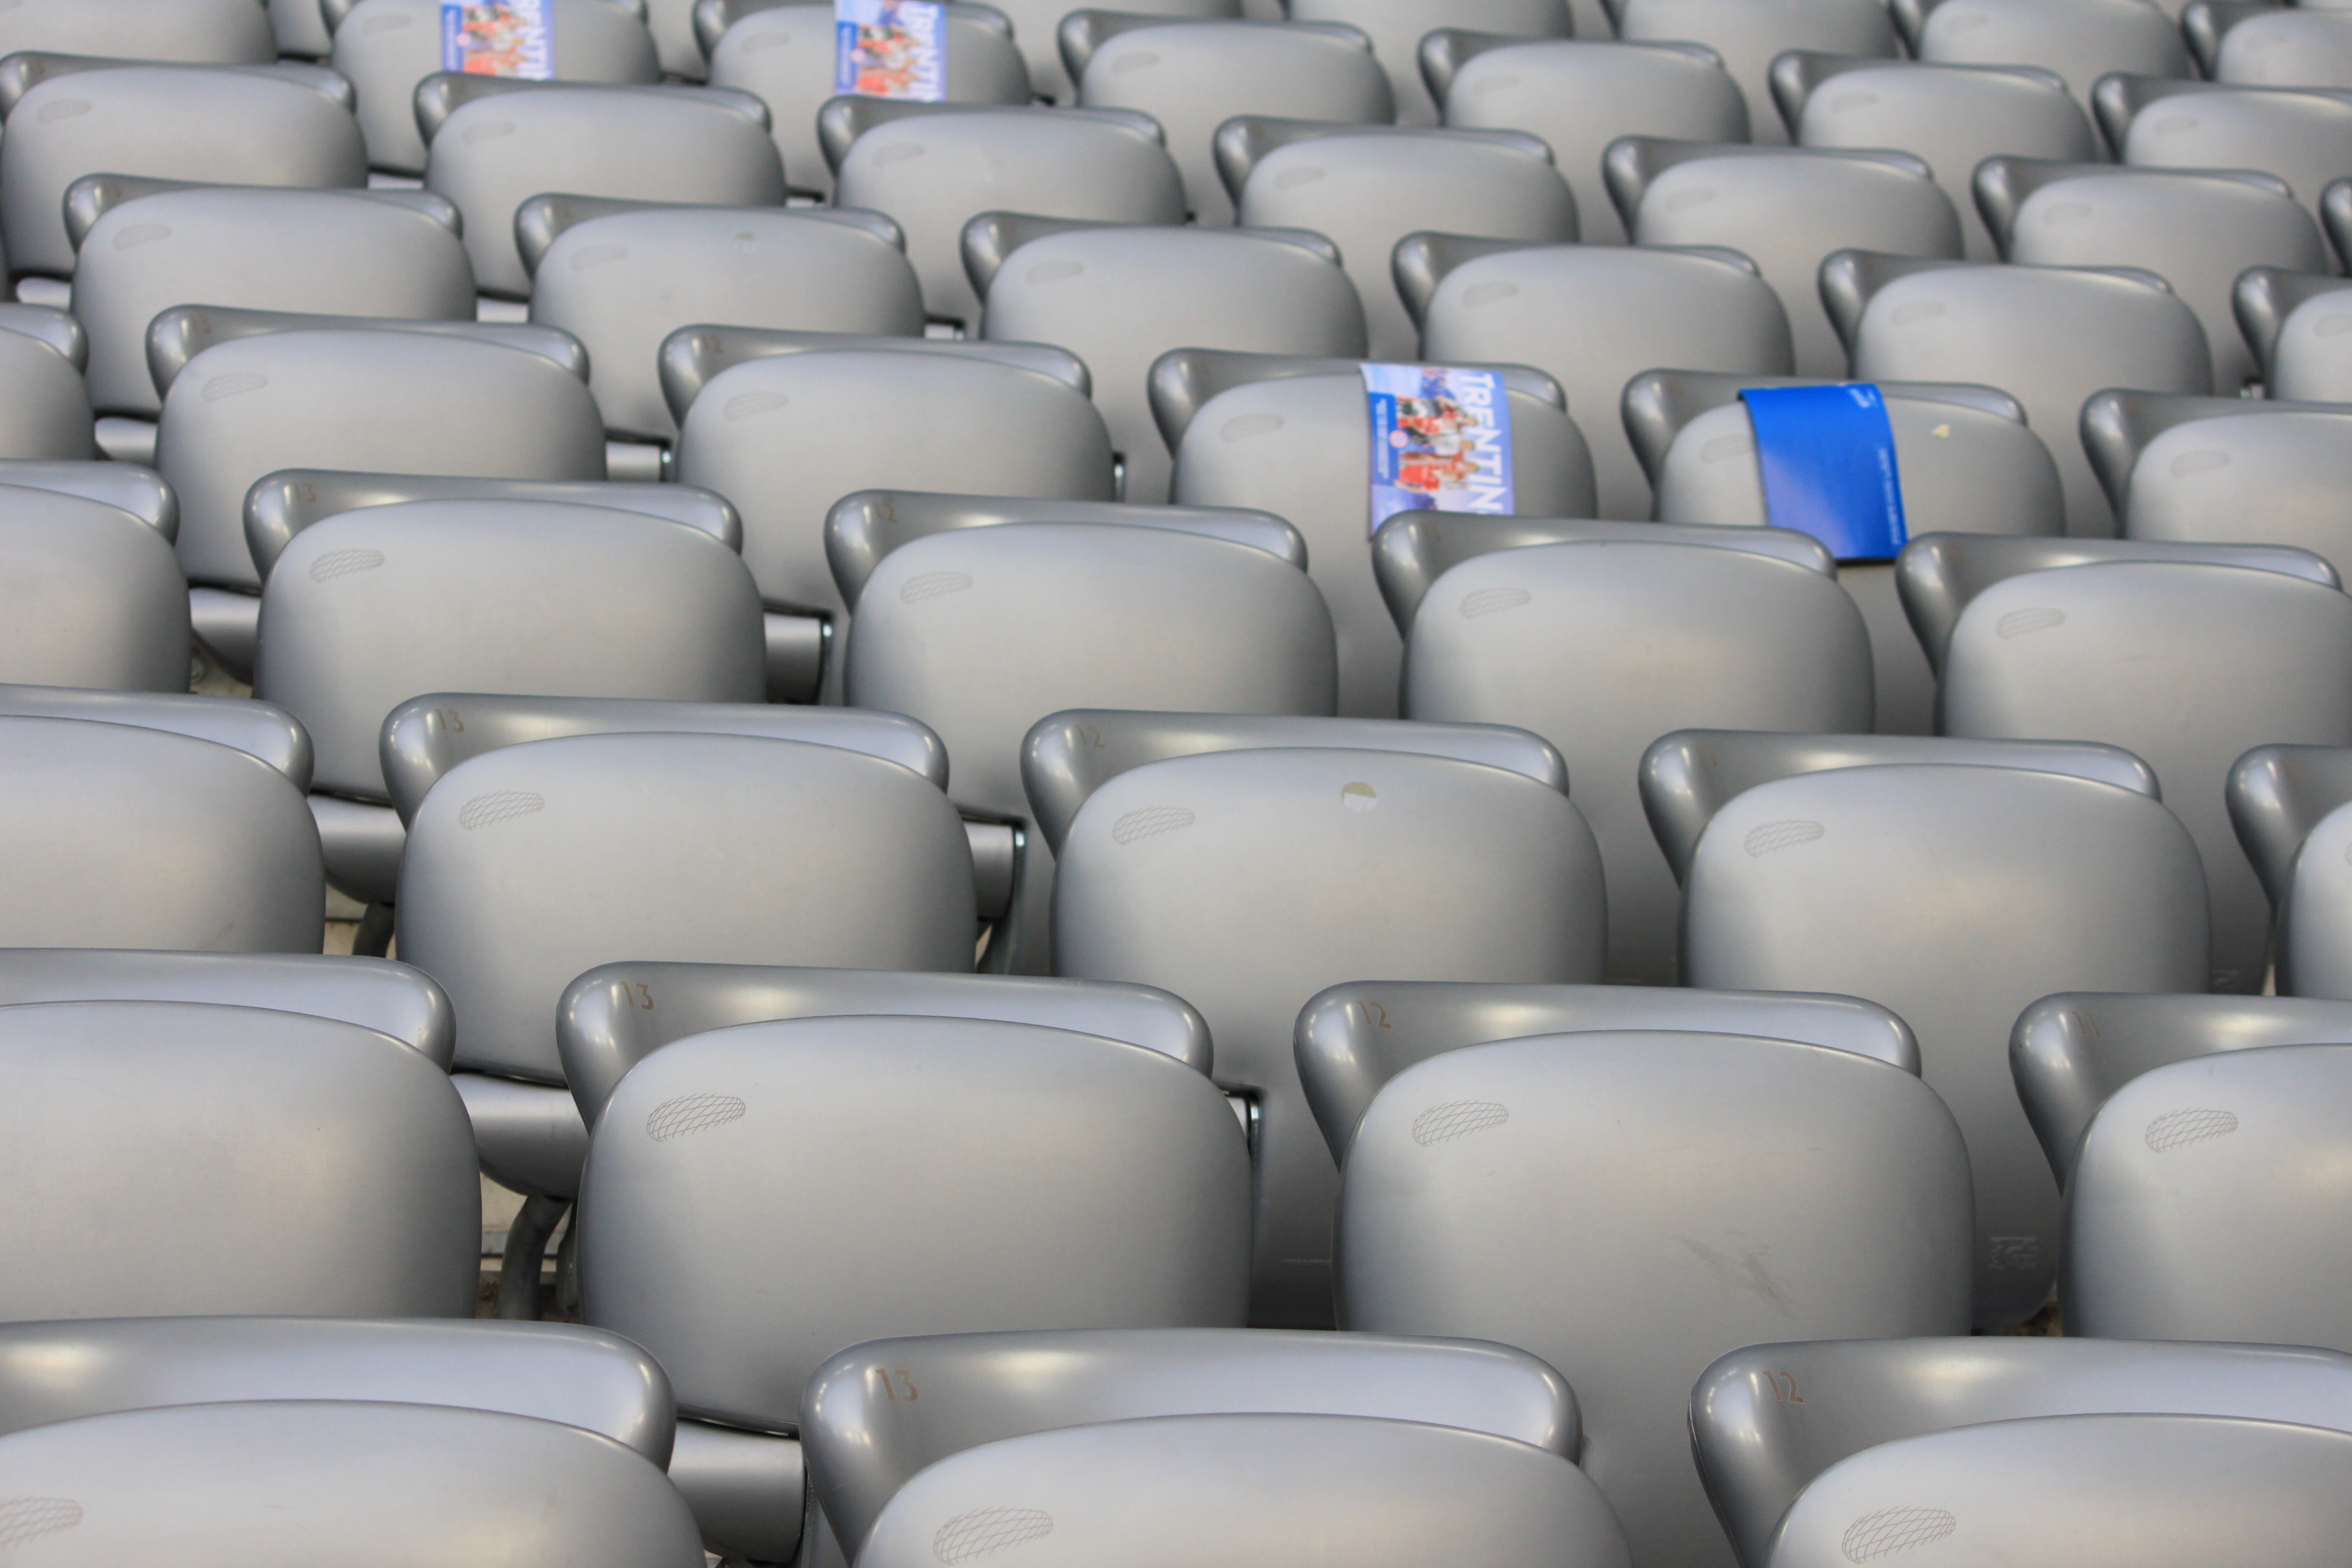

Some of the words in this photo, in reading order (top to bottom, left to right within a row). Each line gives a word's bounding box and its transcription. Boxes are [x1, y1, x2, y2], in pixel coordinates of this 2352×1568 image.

[1459, 373, 1509, 514] TRENTIN
[433, 708, 465, 733] 13
[1075, 724, 1105, 749] 12
[619, 981, 655, 1010] 13
[1356, 1000, 1392, 1029] 12
[2072, 1011, 2102, 1038] 11
[876, 1369, 919, 1402] 13
[1763, 1370, 1804, 1404] 12
